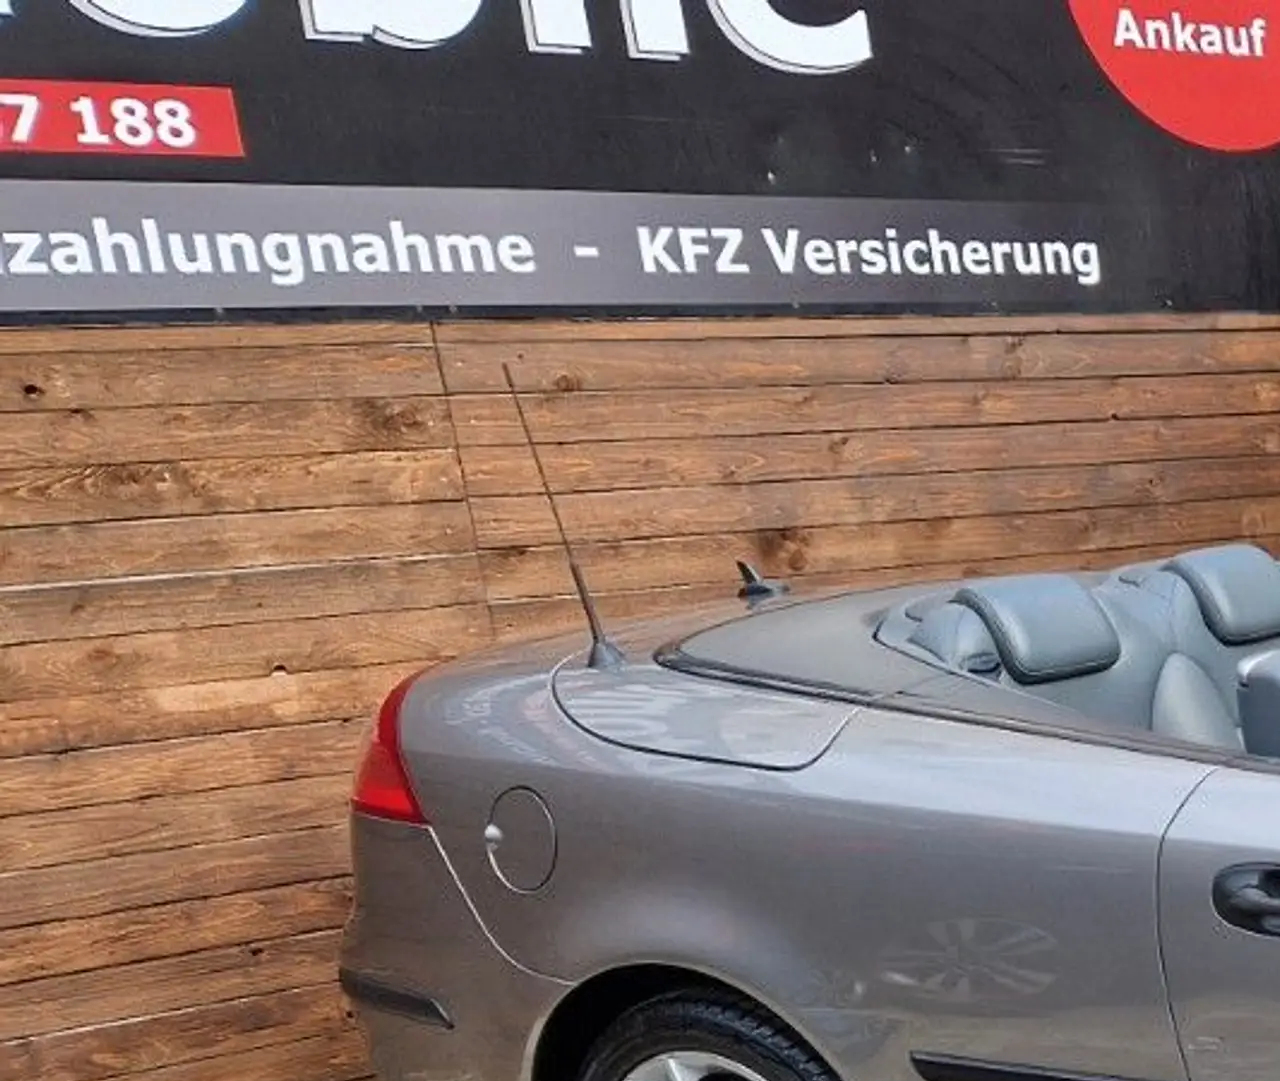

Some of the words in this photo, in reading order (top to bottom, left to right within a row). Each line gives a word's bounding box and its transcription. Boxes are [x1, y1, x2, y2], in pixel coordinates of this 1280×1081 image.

[1112, 9, 1267, 57] Ankauf
[0, 93, 40, 143] 7
[70, 96, 197, 148] 188
[0, 216, 537, 286] zahlungnahme
[636, 226, 750, 274] KFZ
[760, 227, 1101, 286] Versicherung
